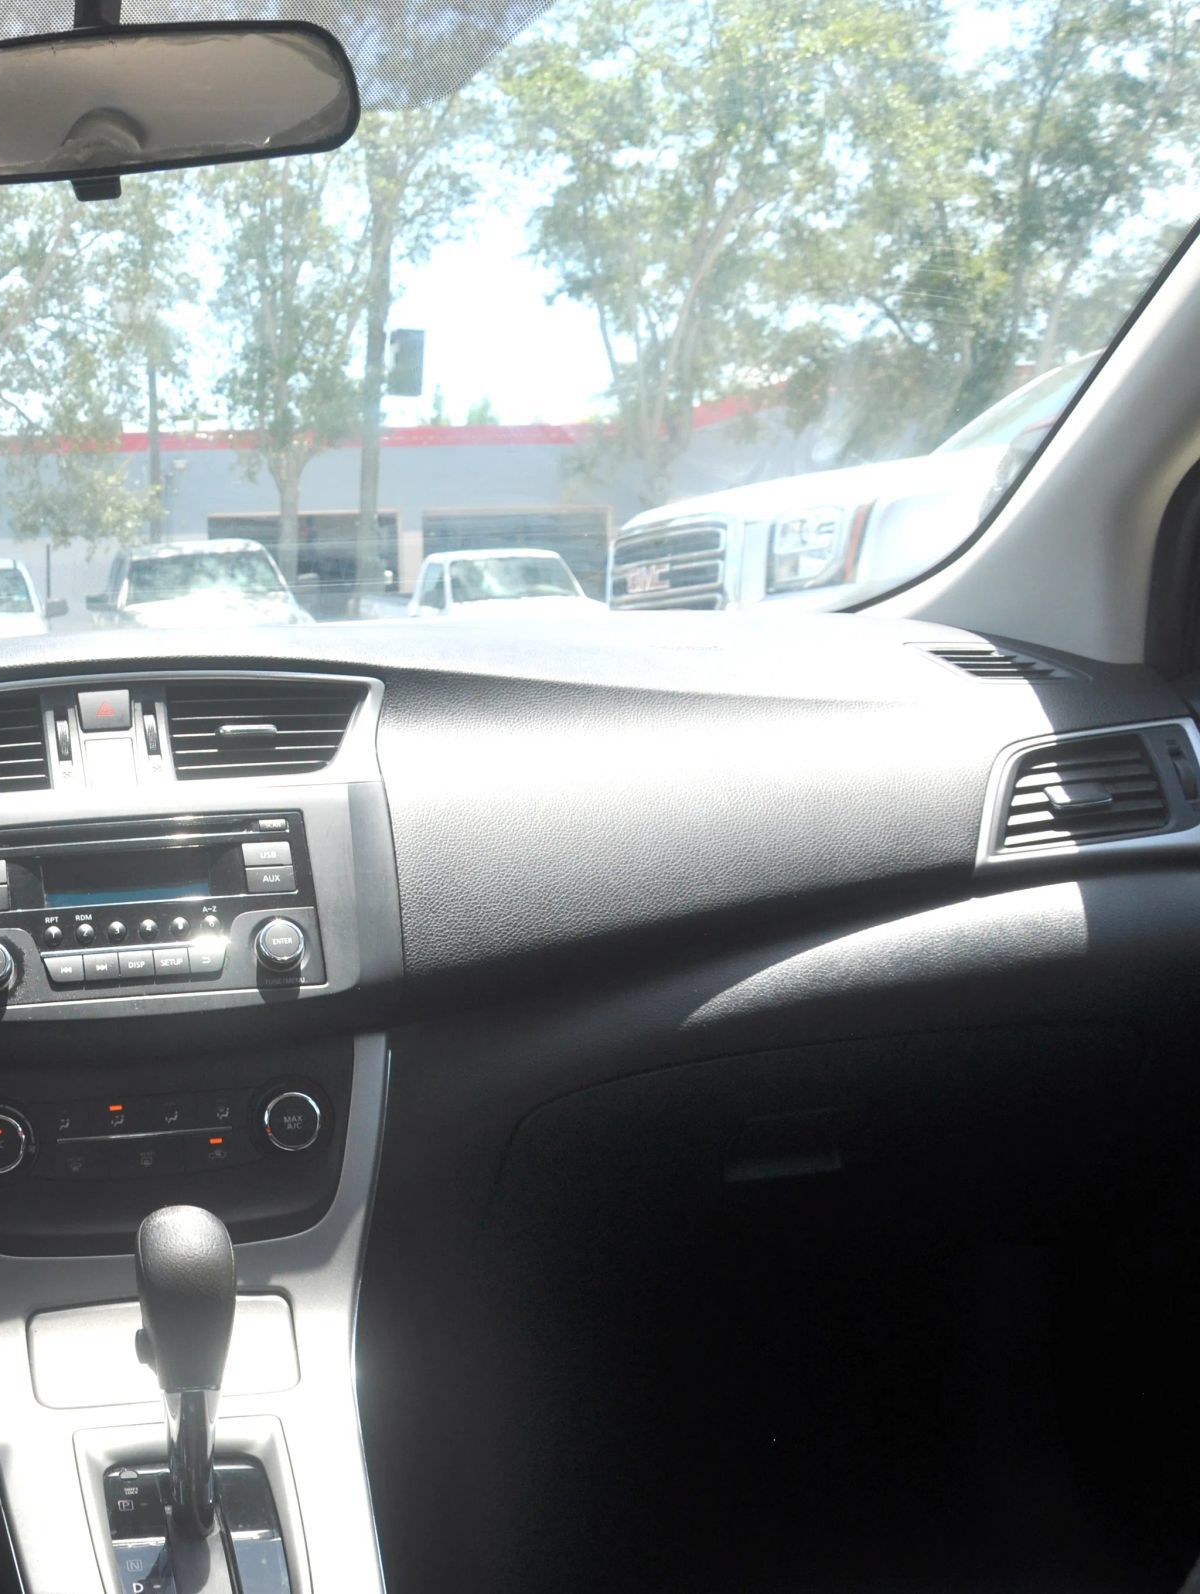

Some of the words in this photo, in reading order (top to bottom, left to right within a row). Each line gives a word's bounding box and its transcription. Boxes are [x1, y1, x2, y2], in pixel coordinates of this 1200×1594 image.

[260, 851, 277, 860] USB
[262, 874, 281, 883] AUX
[44, 916, 59, 924] RPT
[75, 914, 93, 922] RDM
[272, 937, 293, 945] ENTER
[128, 961, 145, 969] DISP
[160, 958, 184, 967] SETUP
[283, 1114, 304, 1124] MAX
[132, 1582, 144, 1594] D
